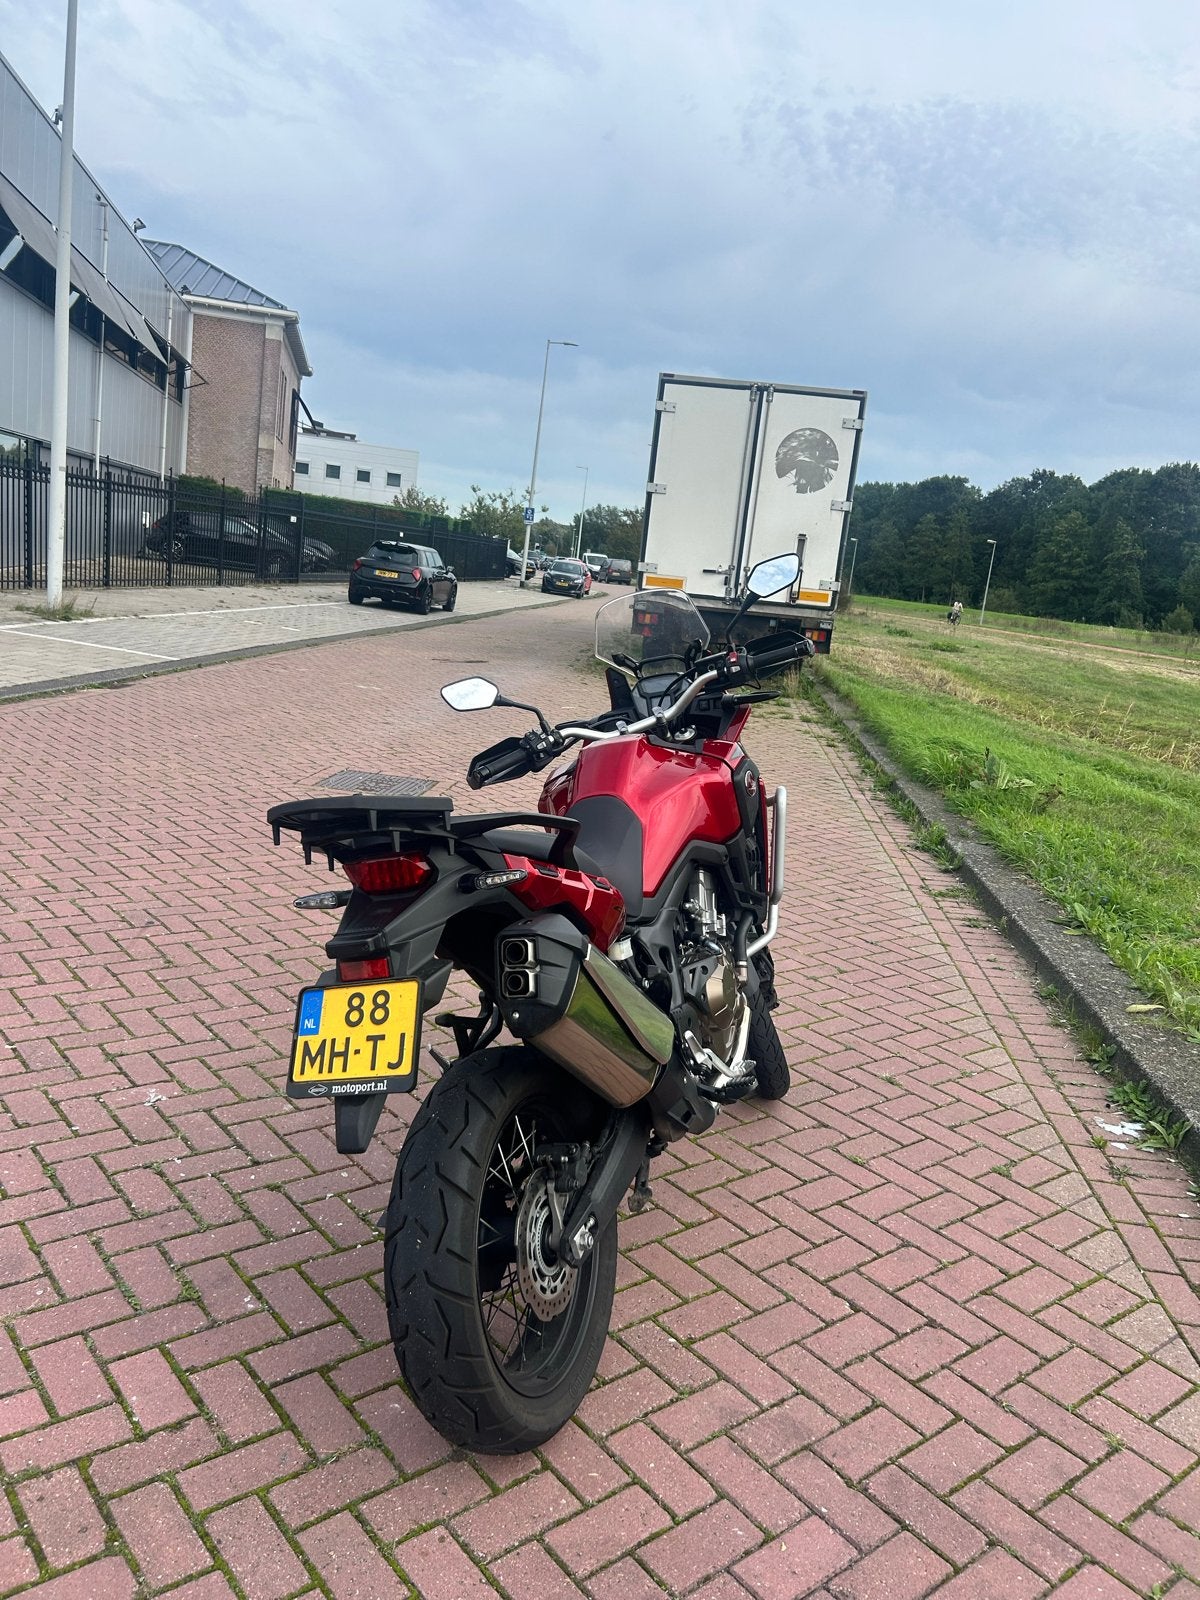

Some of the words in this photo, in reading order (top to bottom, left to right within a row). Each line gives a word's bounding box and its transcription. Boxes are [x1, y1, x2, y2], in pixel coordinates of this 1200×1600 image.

[344, 990, 391, 1028] 88
[304, 1019, 316, 1029] NL
[299, 1033, 406, 1076] MH-TJ
[331, 1080, 388, 1095] motoport.nl
